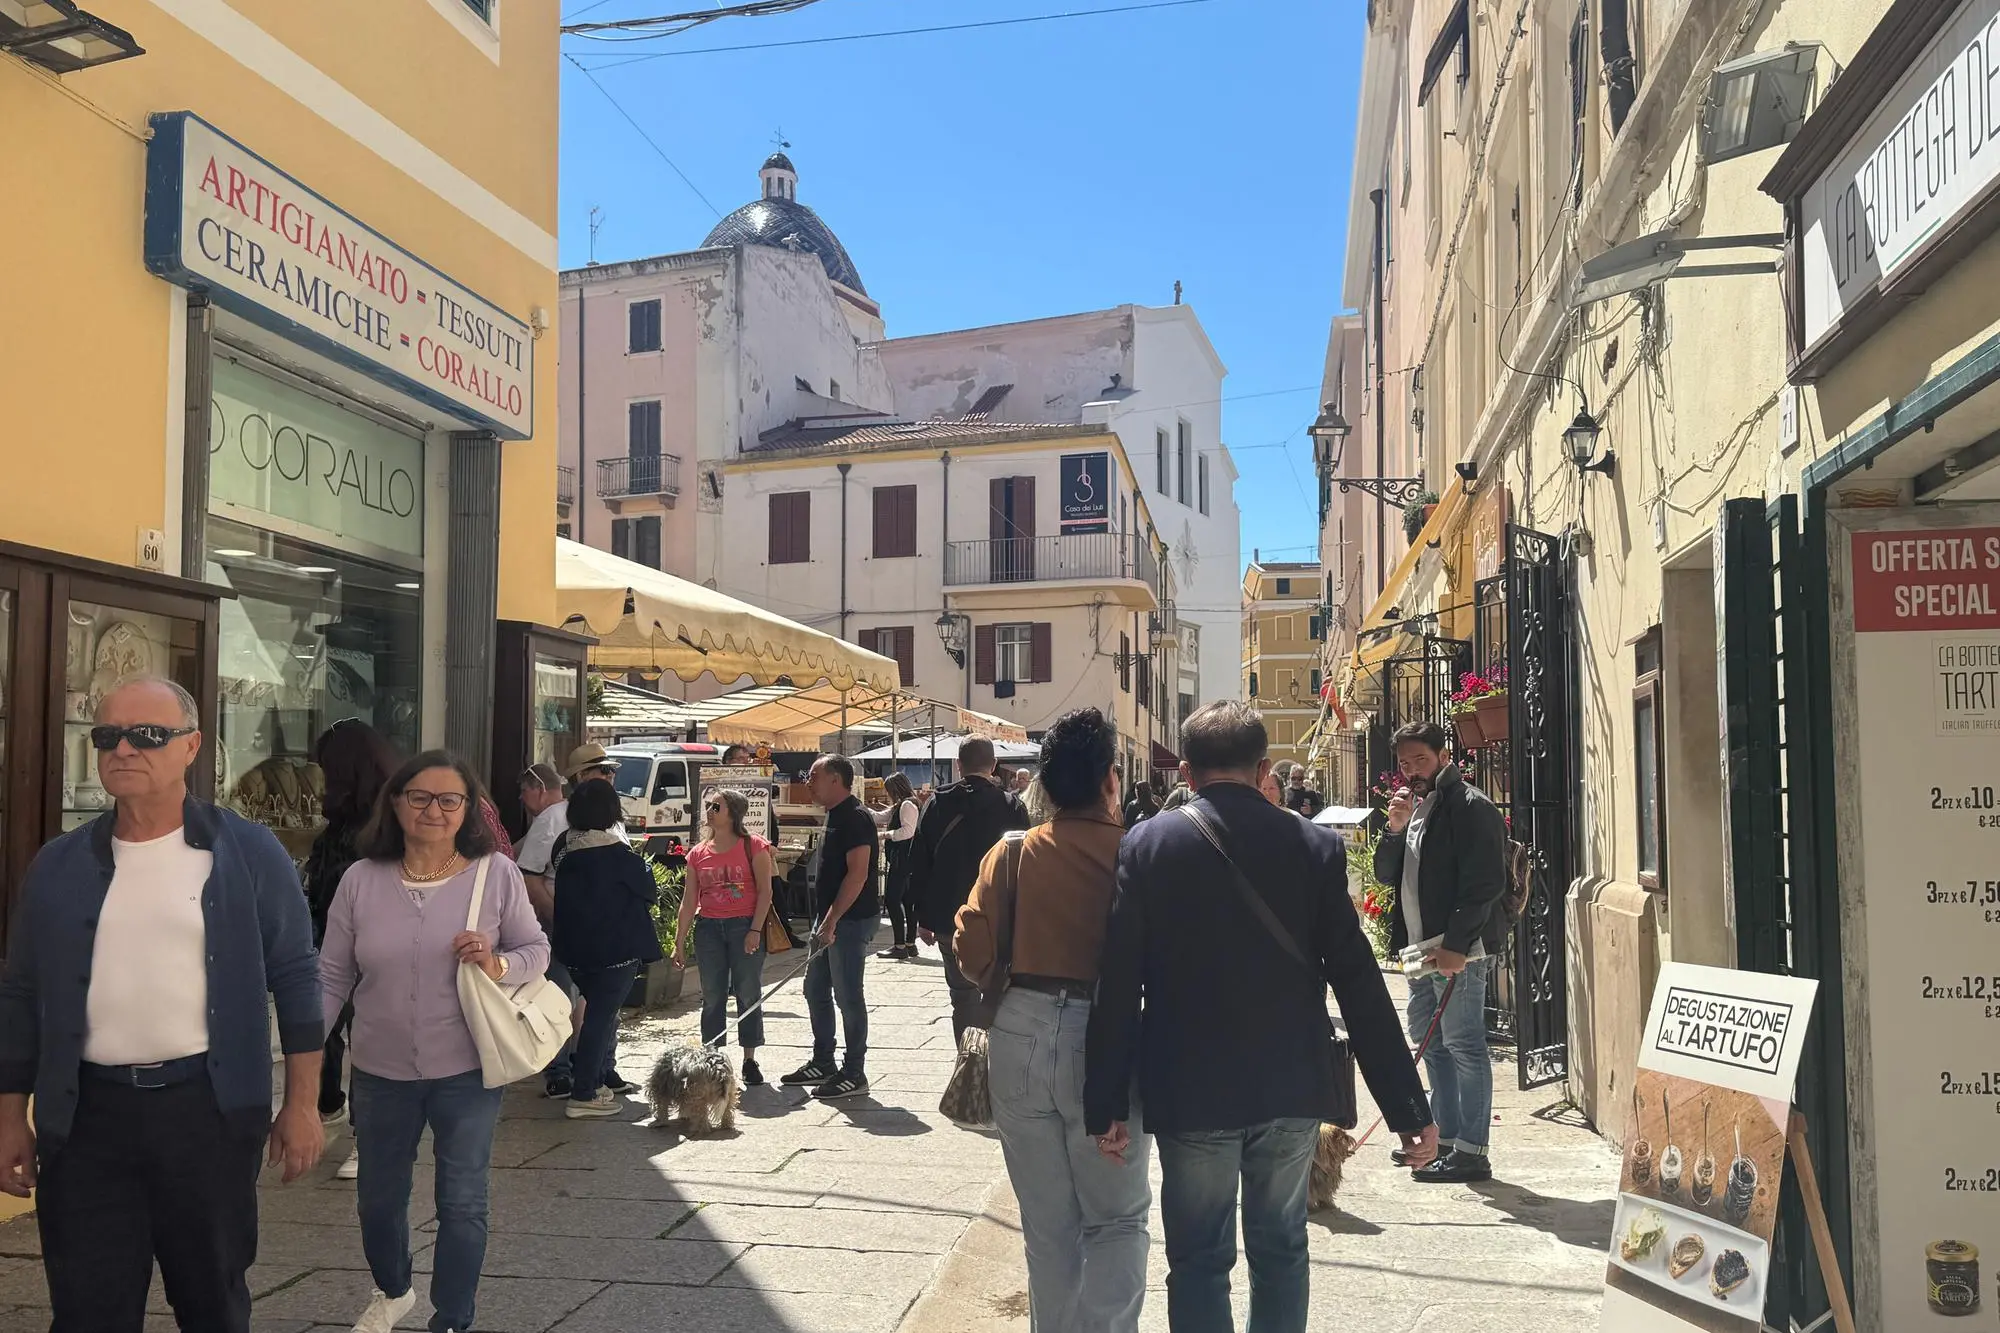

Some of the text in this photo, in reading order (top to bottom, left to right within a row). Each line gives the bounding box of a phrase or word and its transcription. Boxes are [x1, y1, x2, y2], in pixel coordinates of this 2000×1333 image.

[1835, 180, 1857, 290] LA
[1863, 66, 1957, 263] BOTTEGA
[199, 155, 523, 373] ARTIGIANATO TESSUTI
[197, 217, 523, 417] CERAMICHE CORALLO
[240, 414, 415, 518] CORALLO
[1064, 504, 1081, 512] Casa
[143, 543, 158, 562] 60
[1871, 538, 1977, 573] OFFERTA
[1894, 583, 1997, 618] SPECIAL
[1938, 646, 1955, 667] LA
[1939, 671, 1999, 710] TART
[1667, 996, 1786, 1033] DEGUSTAZIONE
[1660, 1020, 1778, 1064] AL TARTUFO
